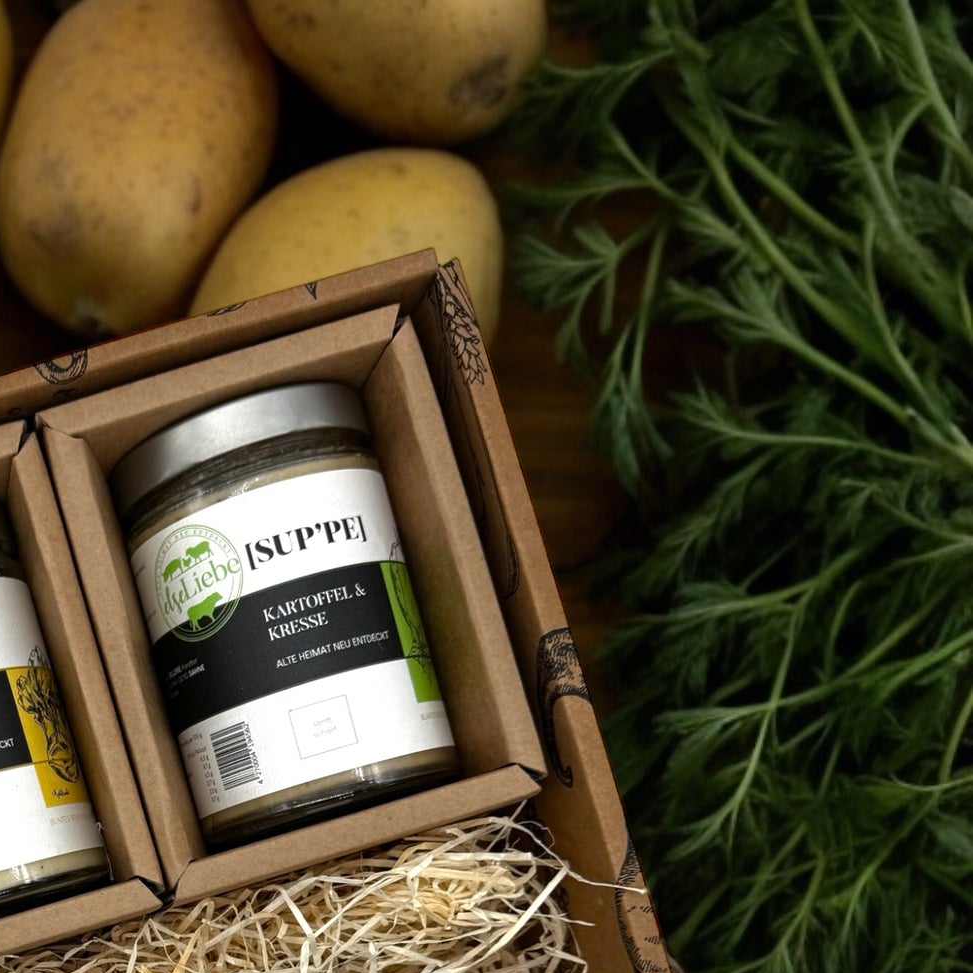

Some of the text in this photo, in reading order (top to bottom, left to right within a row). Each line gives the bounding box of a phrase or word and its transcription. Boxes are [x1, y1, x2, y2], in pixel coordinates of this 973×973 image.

[245, 515, 367, 571] [SUP'PE]
[262, 582, 367, 623] KARTOFFEL &
[267, 611, 329, 642] KRESSE
[276, 630, 390, 669] ALTE HEIMAT NEU ENTDECKT
